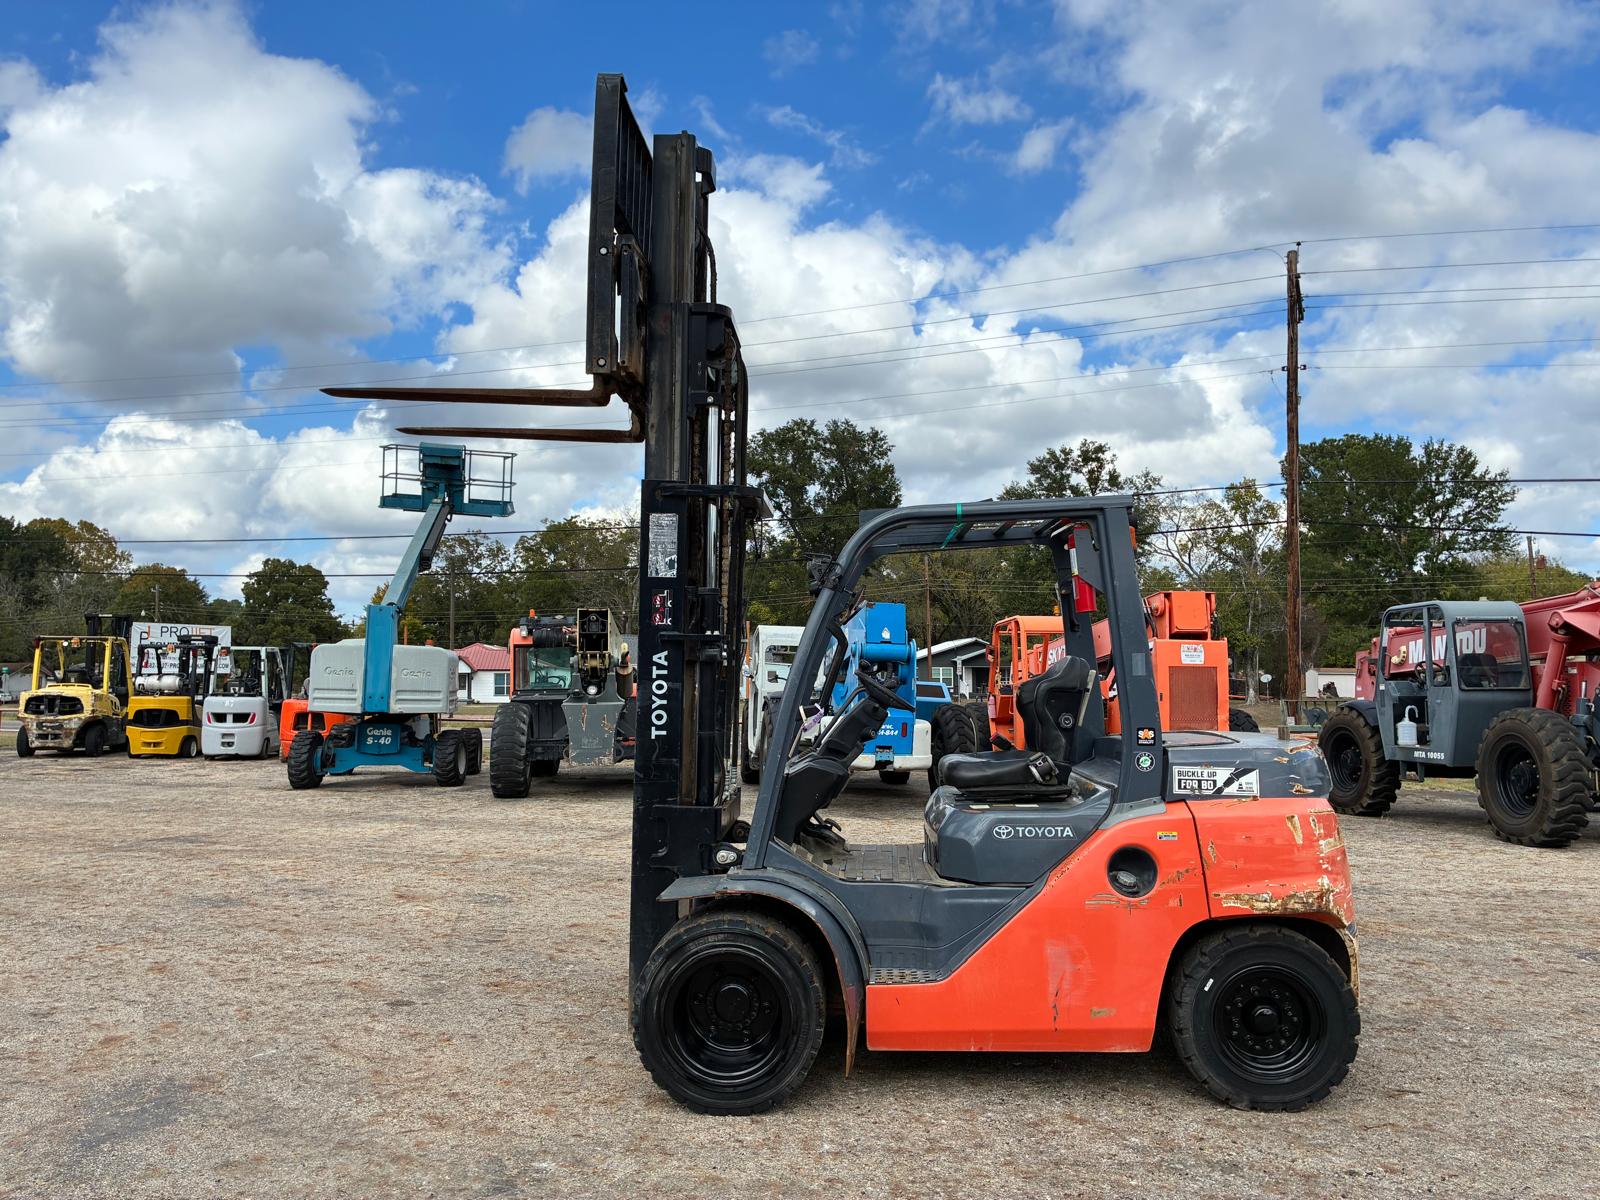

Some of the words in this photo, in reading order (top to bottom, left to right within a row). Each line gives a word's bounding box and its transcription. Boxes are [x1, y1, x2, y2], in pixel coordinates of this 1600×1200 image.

[651, 650, 668, 739] TOYOTA
[366, 727, 392, 736] Genie
[1413, 750, 1426, 759] MTA
[1427, 751, 1445, 760] 10055
[1177, 770, 1205, 778] BUCKLE
[1181, 780, 1198, 790] FOR
[1015, 826, 1074, 837] TOYOTA
